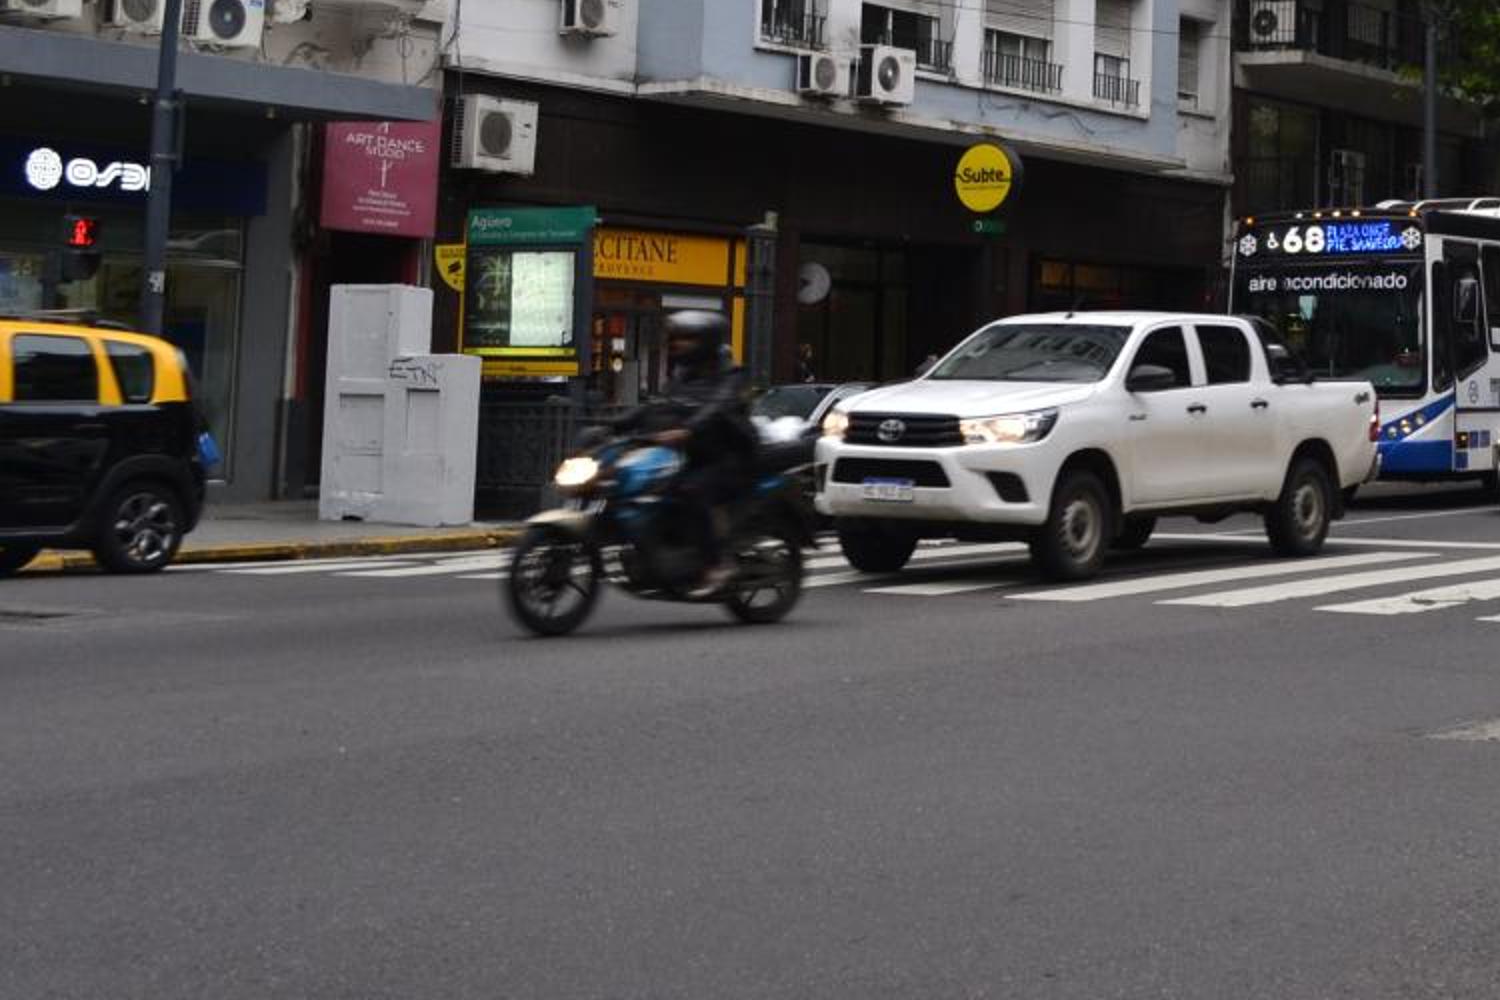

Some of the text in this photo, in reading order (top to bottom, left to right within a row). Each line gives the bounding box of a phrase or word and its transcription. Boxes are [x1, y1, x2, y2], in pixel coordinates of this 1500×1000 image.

[346, 133, 425, 153] ART DANCE
[959, 167, 1009, 184] Subte
[1282, 225, 1325, 254] 68
[1248, 275, 1277, 292] aire
